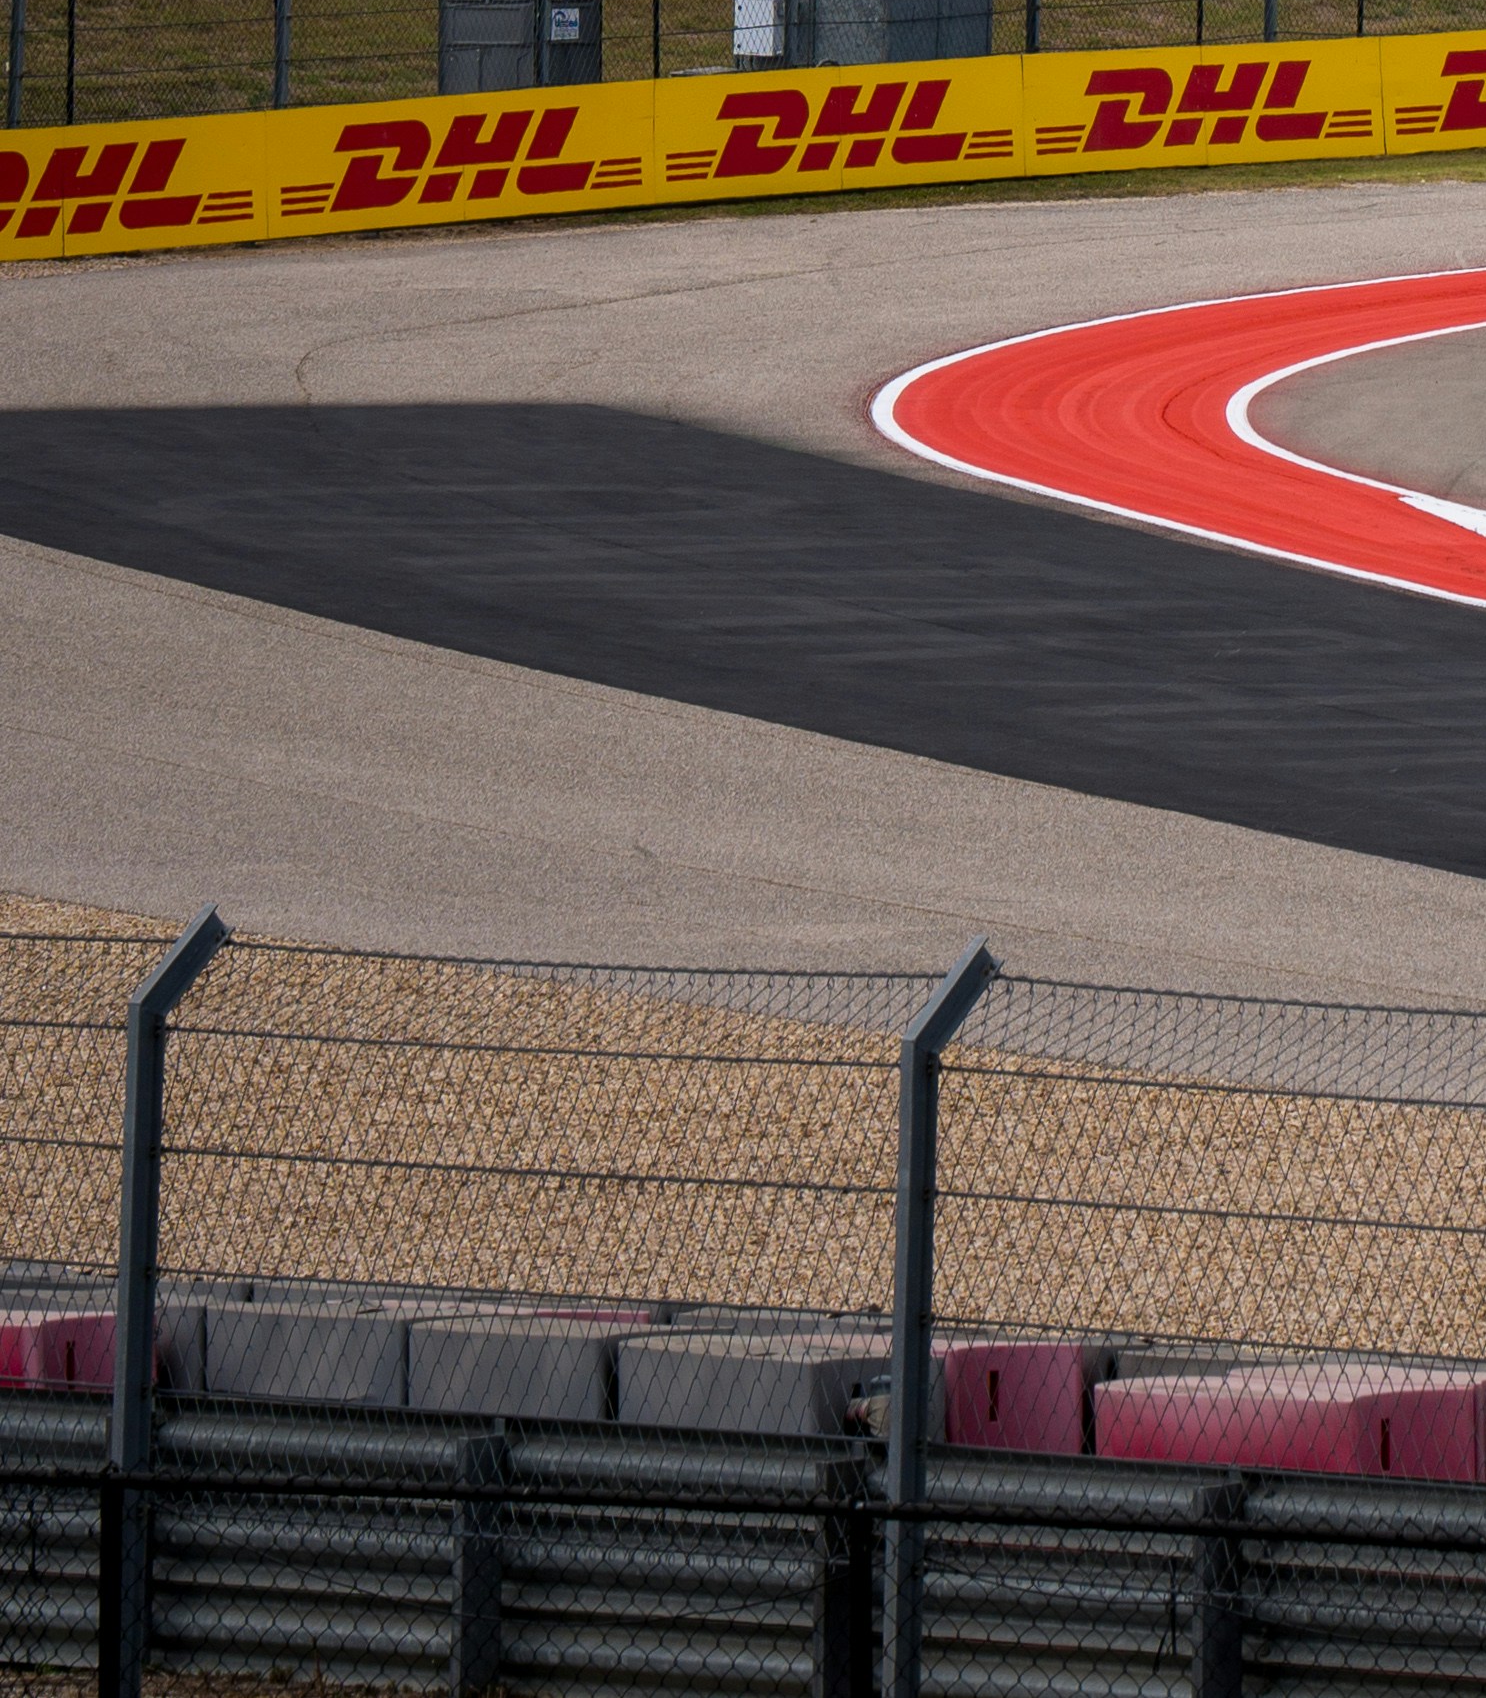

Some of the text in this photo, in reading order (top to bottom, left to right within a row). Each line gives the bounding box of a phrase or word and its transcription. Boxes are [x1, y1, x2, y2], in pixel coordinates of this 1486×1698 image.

[714, 80, 966, 178] DHL
[1083, 61, 1327, 152] DHL
[330, 107, 593, 212] DHL
